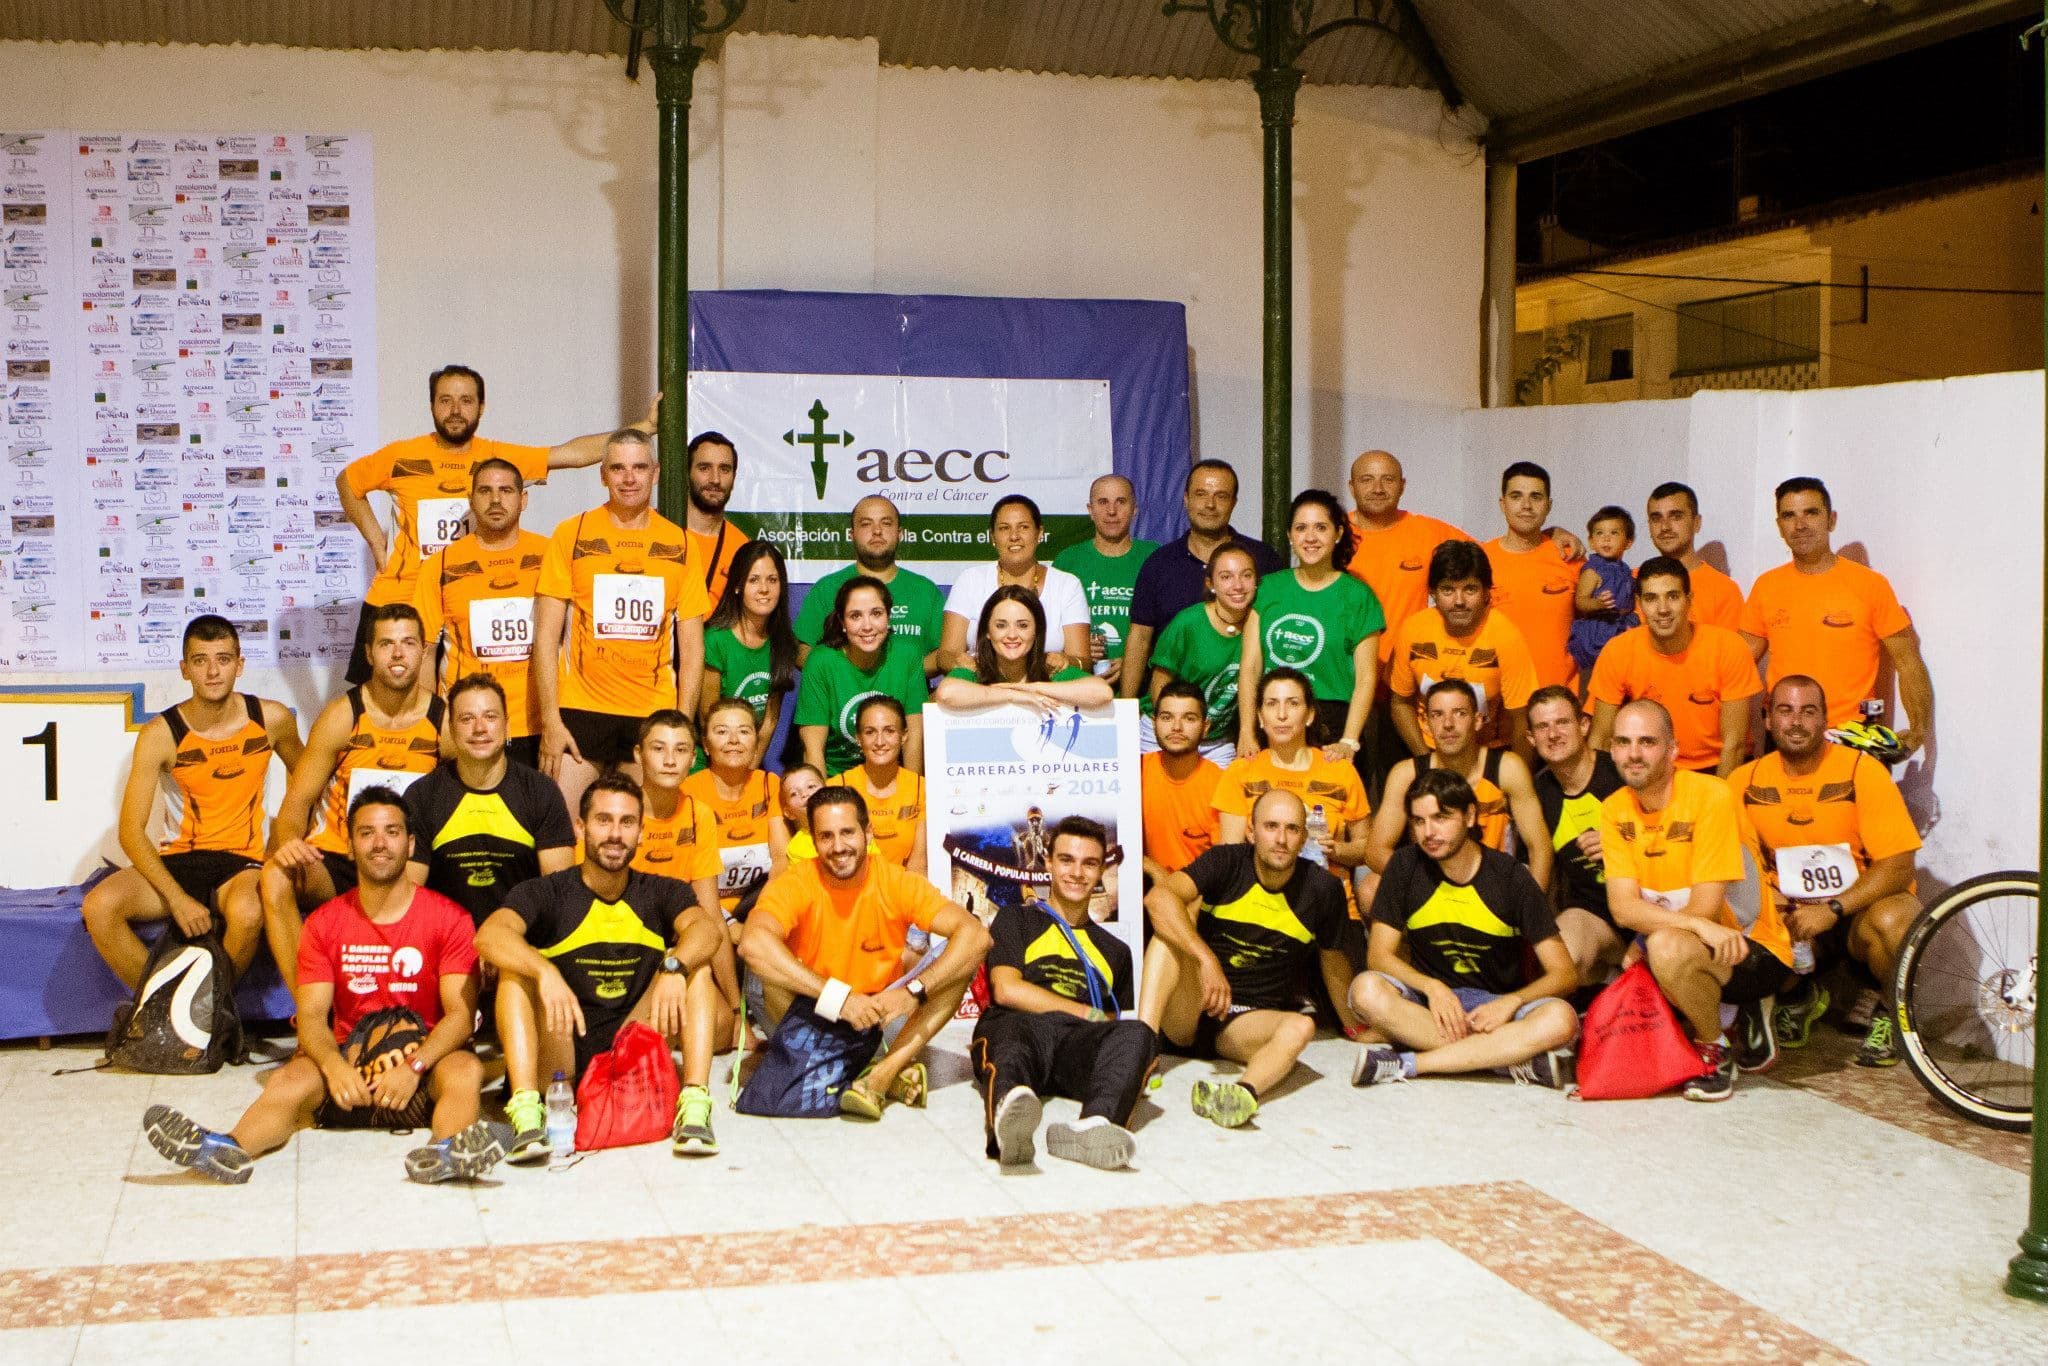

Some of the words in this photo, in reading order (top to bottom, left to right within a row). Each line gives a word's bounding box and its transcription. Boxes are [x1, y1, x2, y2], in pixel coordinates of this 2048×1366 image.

[86, 445, 129, 453] nosolomovil
[856, 448, 1010, 483] aecc
[182, 491, 224, 499] nosolomovil
[878, 488, 923, 501] Contra
[927, 488, 940, 501] el
[942, 488, 989, 501] Cáncer
[437, 519, 470, 541] 821
[756, 528, 841, 543] Asociación
[922, 529, 972, 543] Contra
[976, 528, 990, 543] el
[1101, 586, 1134, 597] aecc
[615, 597, 653, 622] 906
[491, 618, 528, 641] 859
[602, 623, 649, 635] Cruzcampo
[481, 645, 528, 656] Cruzcampo
[22, 721, 58, 801] 1
[946, 764, 1026, 777] CARRERAS
[1032, 761, 1119, 774] POPULARES
[1067, 778, 1121, 796] 2014
[960, 851, 993, 872] CARRERA
[994, 864, 1030, 881] POPULAR
[726, 866, 764, 887] 970
[1802, 865, 1843, 892] 899
[342, 963, 390, 973] NOCTURN
